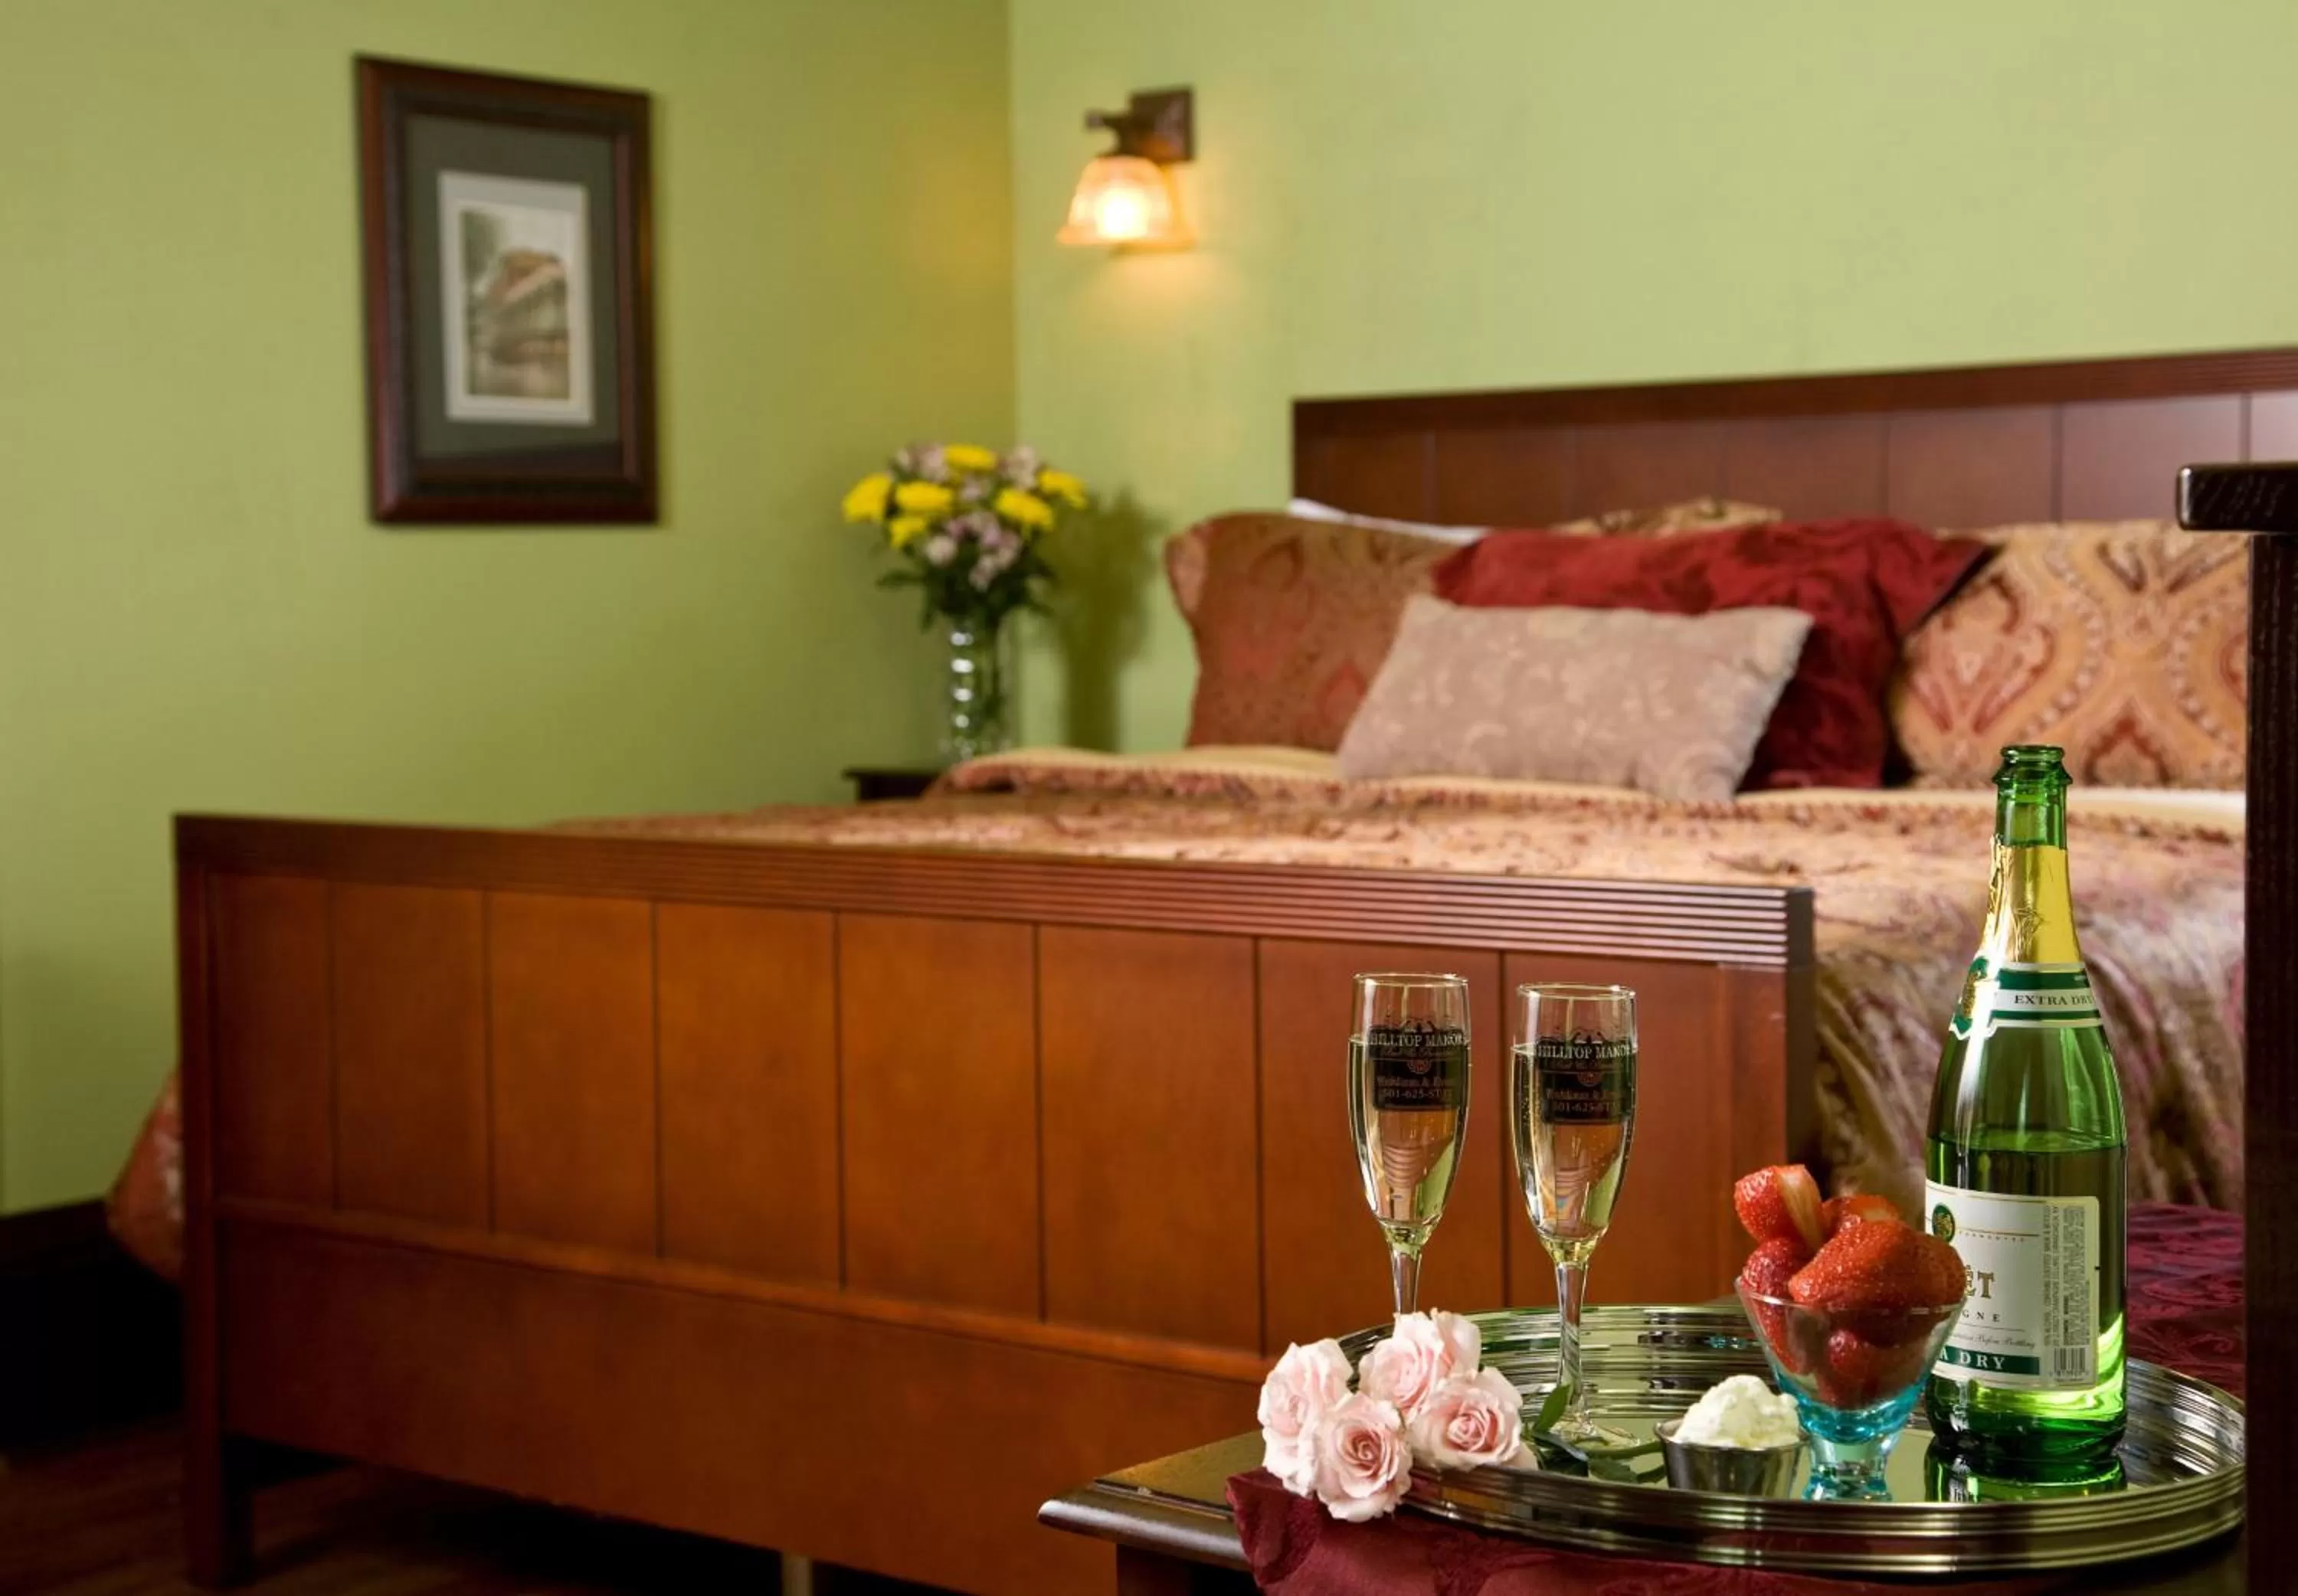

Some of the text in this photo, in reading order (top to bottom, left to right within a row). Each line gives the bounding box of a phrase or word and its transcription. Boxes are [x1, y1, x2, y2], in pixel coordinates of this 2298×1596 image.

[2014, 995, 2067, 1006] EXTRA
[1369, 1032, 1422, 1048] HILLTOP
[1537, 1045, 1593, 1059] HILLTOP
[1960, 1351, 2005, 1370] DRY
